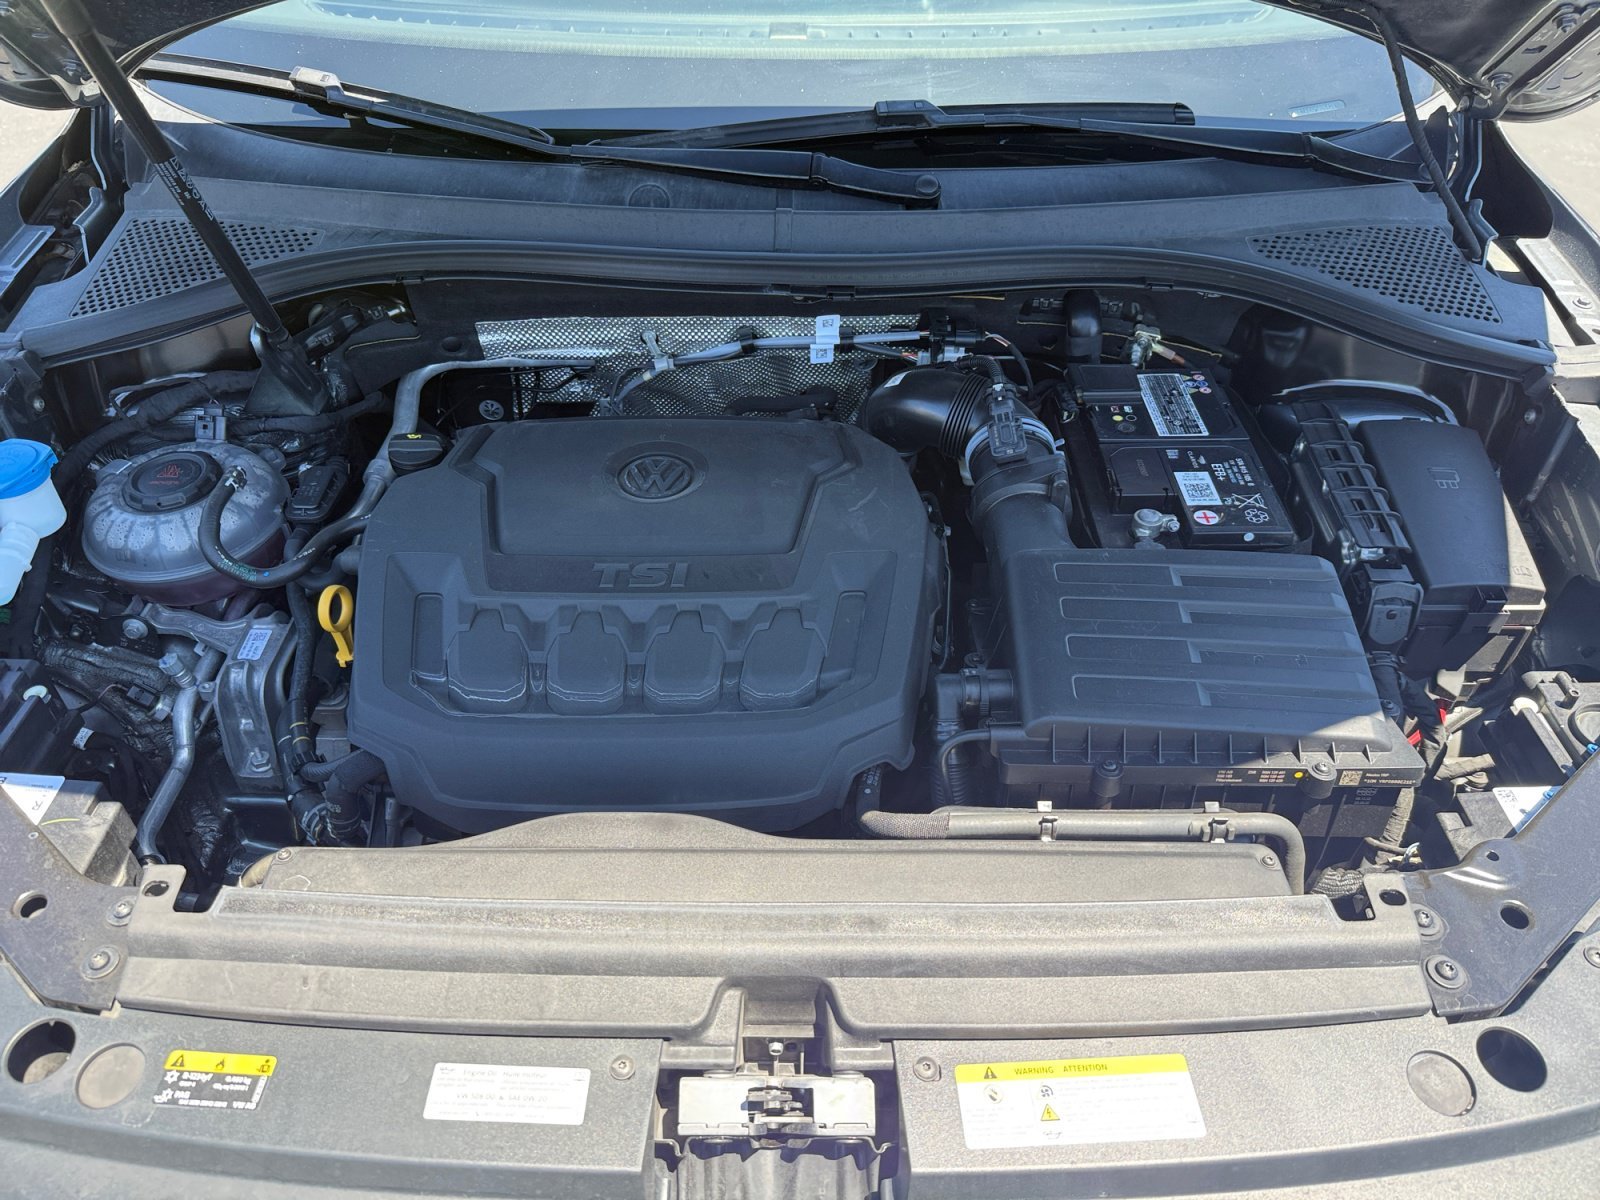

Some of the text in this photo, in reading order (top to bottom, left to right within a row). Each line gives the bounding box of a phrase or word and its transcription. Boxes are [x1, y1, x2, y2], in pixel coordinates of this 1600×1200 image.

[617, 454, 692, 499] VW
[1211, 463, 1227, 481] EFB+
[592, 562, 690, 588] TSI
[1014, 1063, 1108, 1075] WARNING ATTENTION
